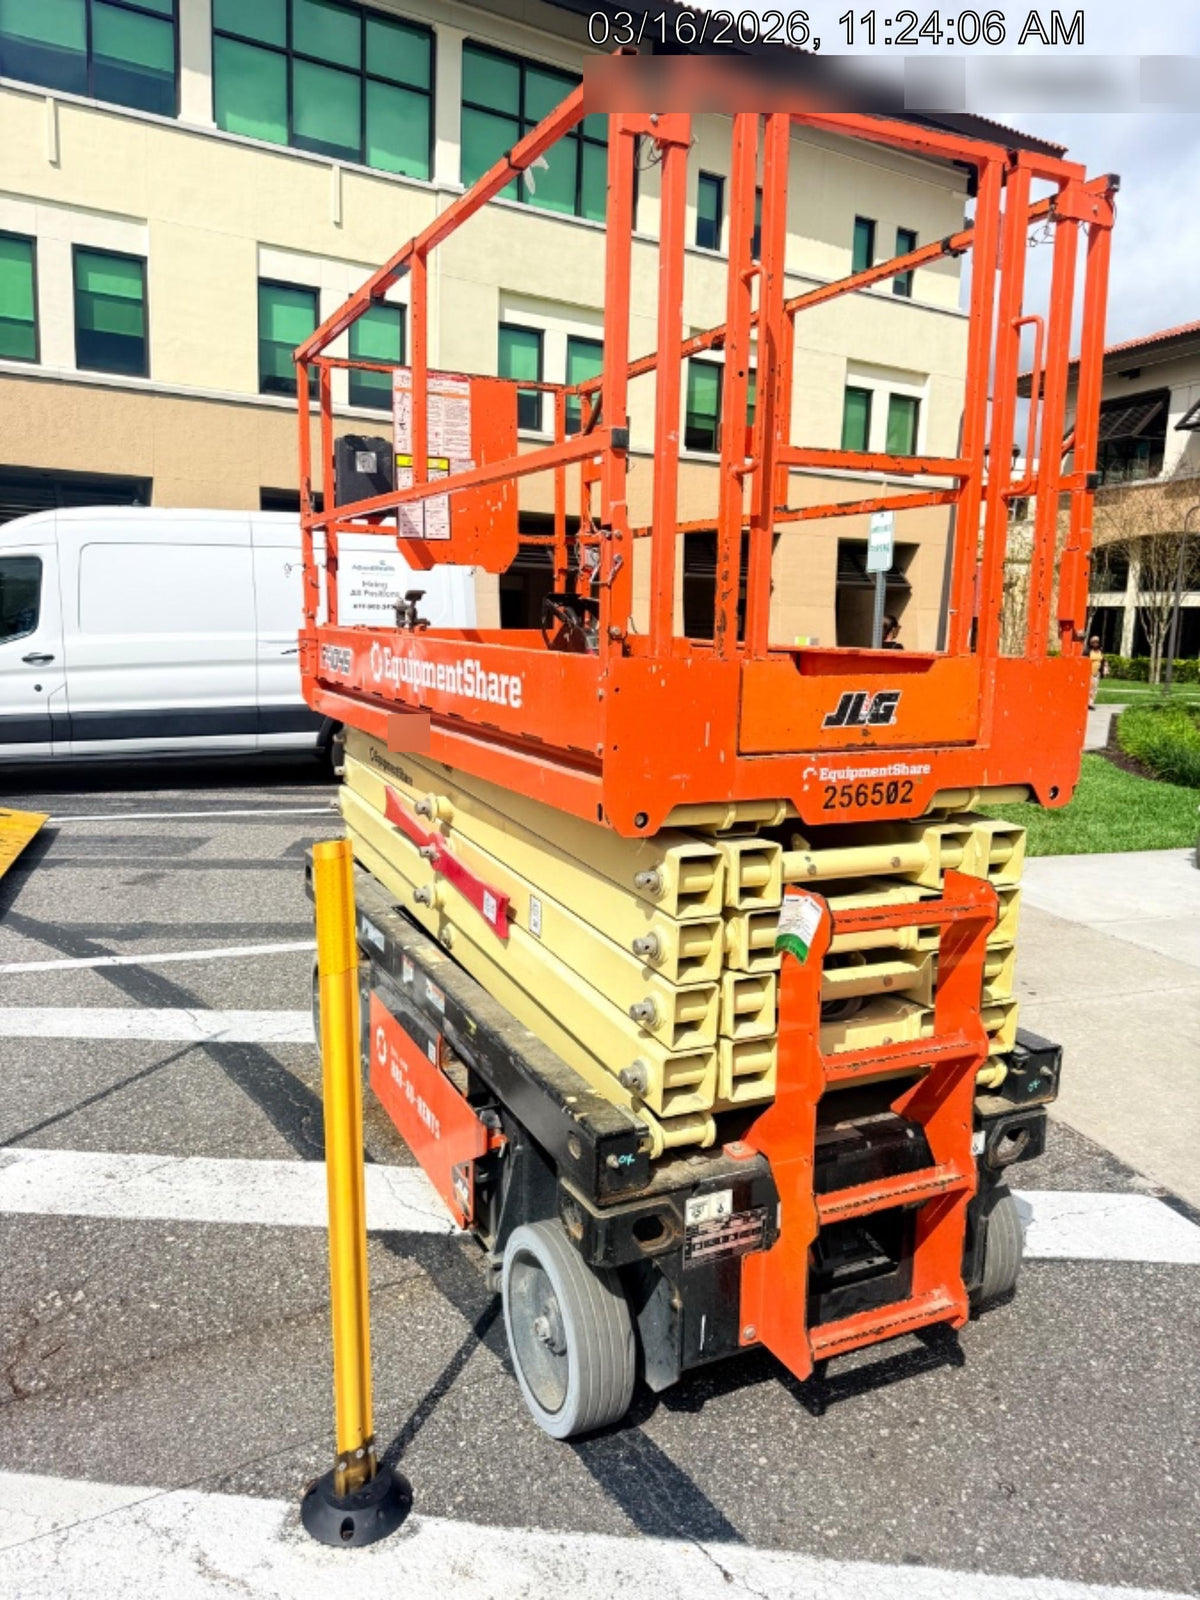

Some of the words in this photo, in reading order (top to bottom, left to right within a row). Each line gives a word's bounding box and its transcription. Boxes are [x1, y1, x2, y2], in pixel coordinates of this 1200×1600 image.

[384, 646, 523, 709] EquipmentShare
[822, 689, 902, 729] JLG
[818, 763, 931, 783] EquipmentShare
[823, 780, 914, 809] 256502
